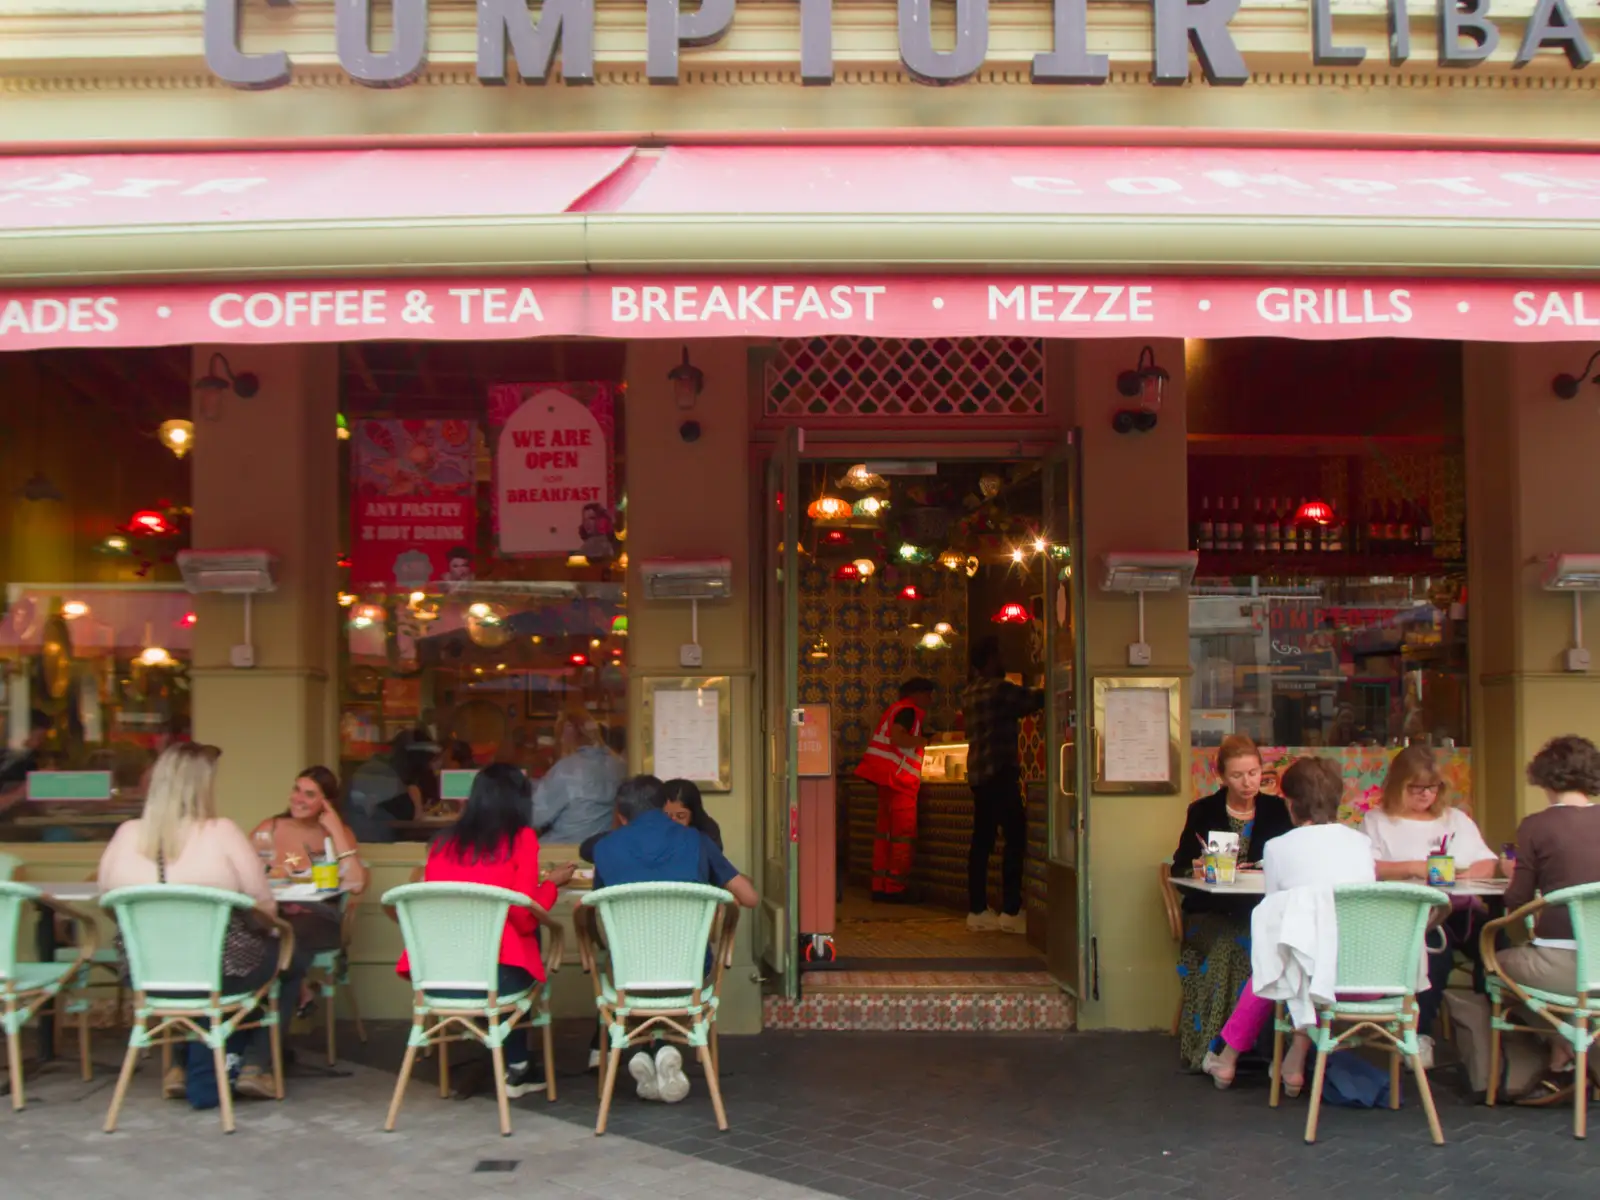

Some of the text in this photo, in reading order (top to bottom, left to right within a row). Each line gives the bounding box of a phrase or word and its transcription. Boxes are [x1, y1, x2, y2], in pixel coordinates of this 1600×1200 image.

[0, 285, 1600, 334] ADES COFFEE & TEA BREAKFAST MEZZE GRILLS SAL
[511, 428, 593, 448] WE ARE
[525, 451, 578, 469] OPEN
[506, 487, 602, 503] BREAKFAST
[364, 502, 462, 517] ANY PASTRY
[377, 525, 411, 540] HOT
[413, 525, 464, 540] DRINK
